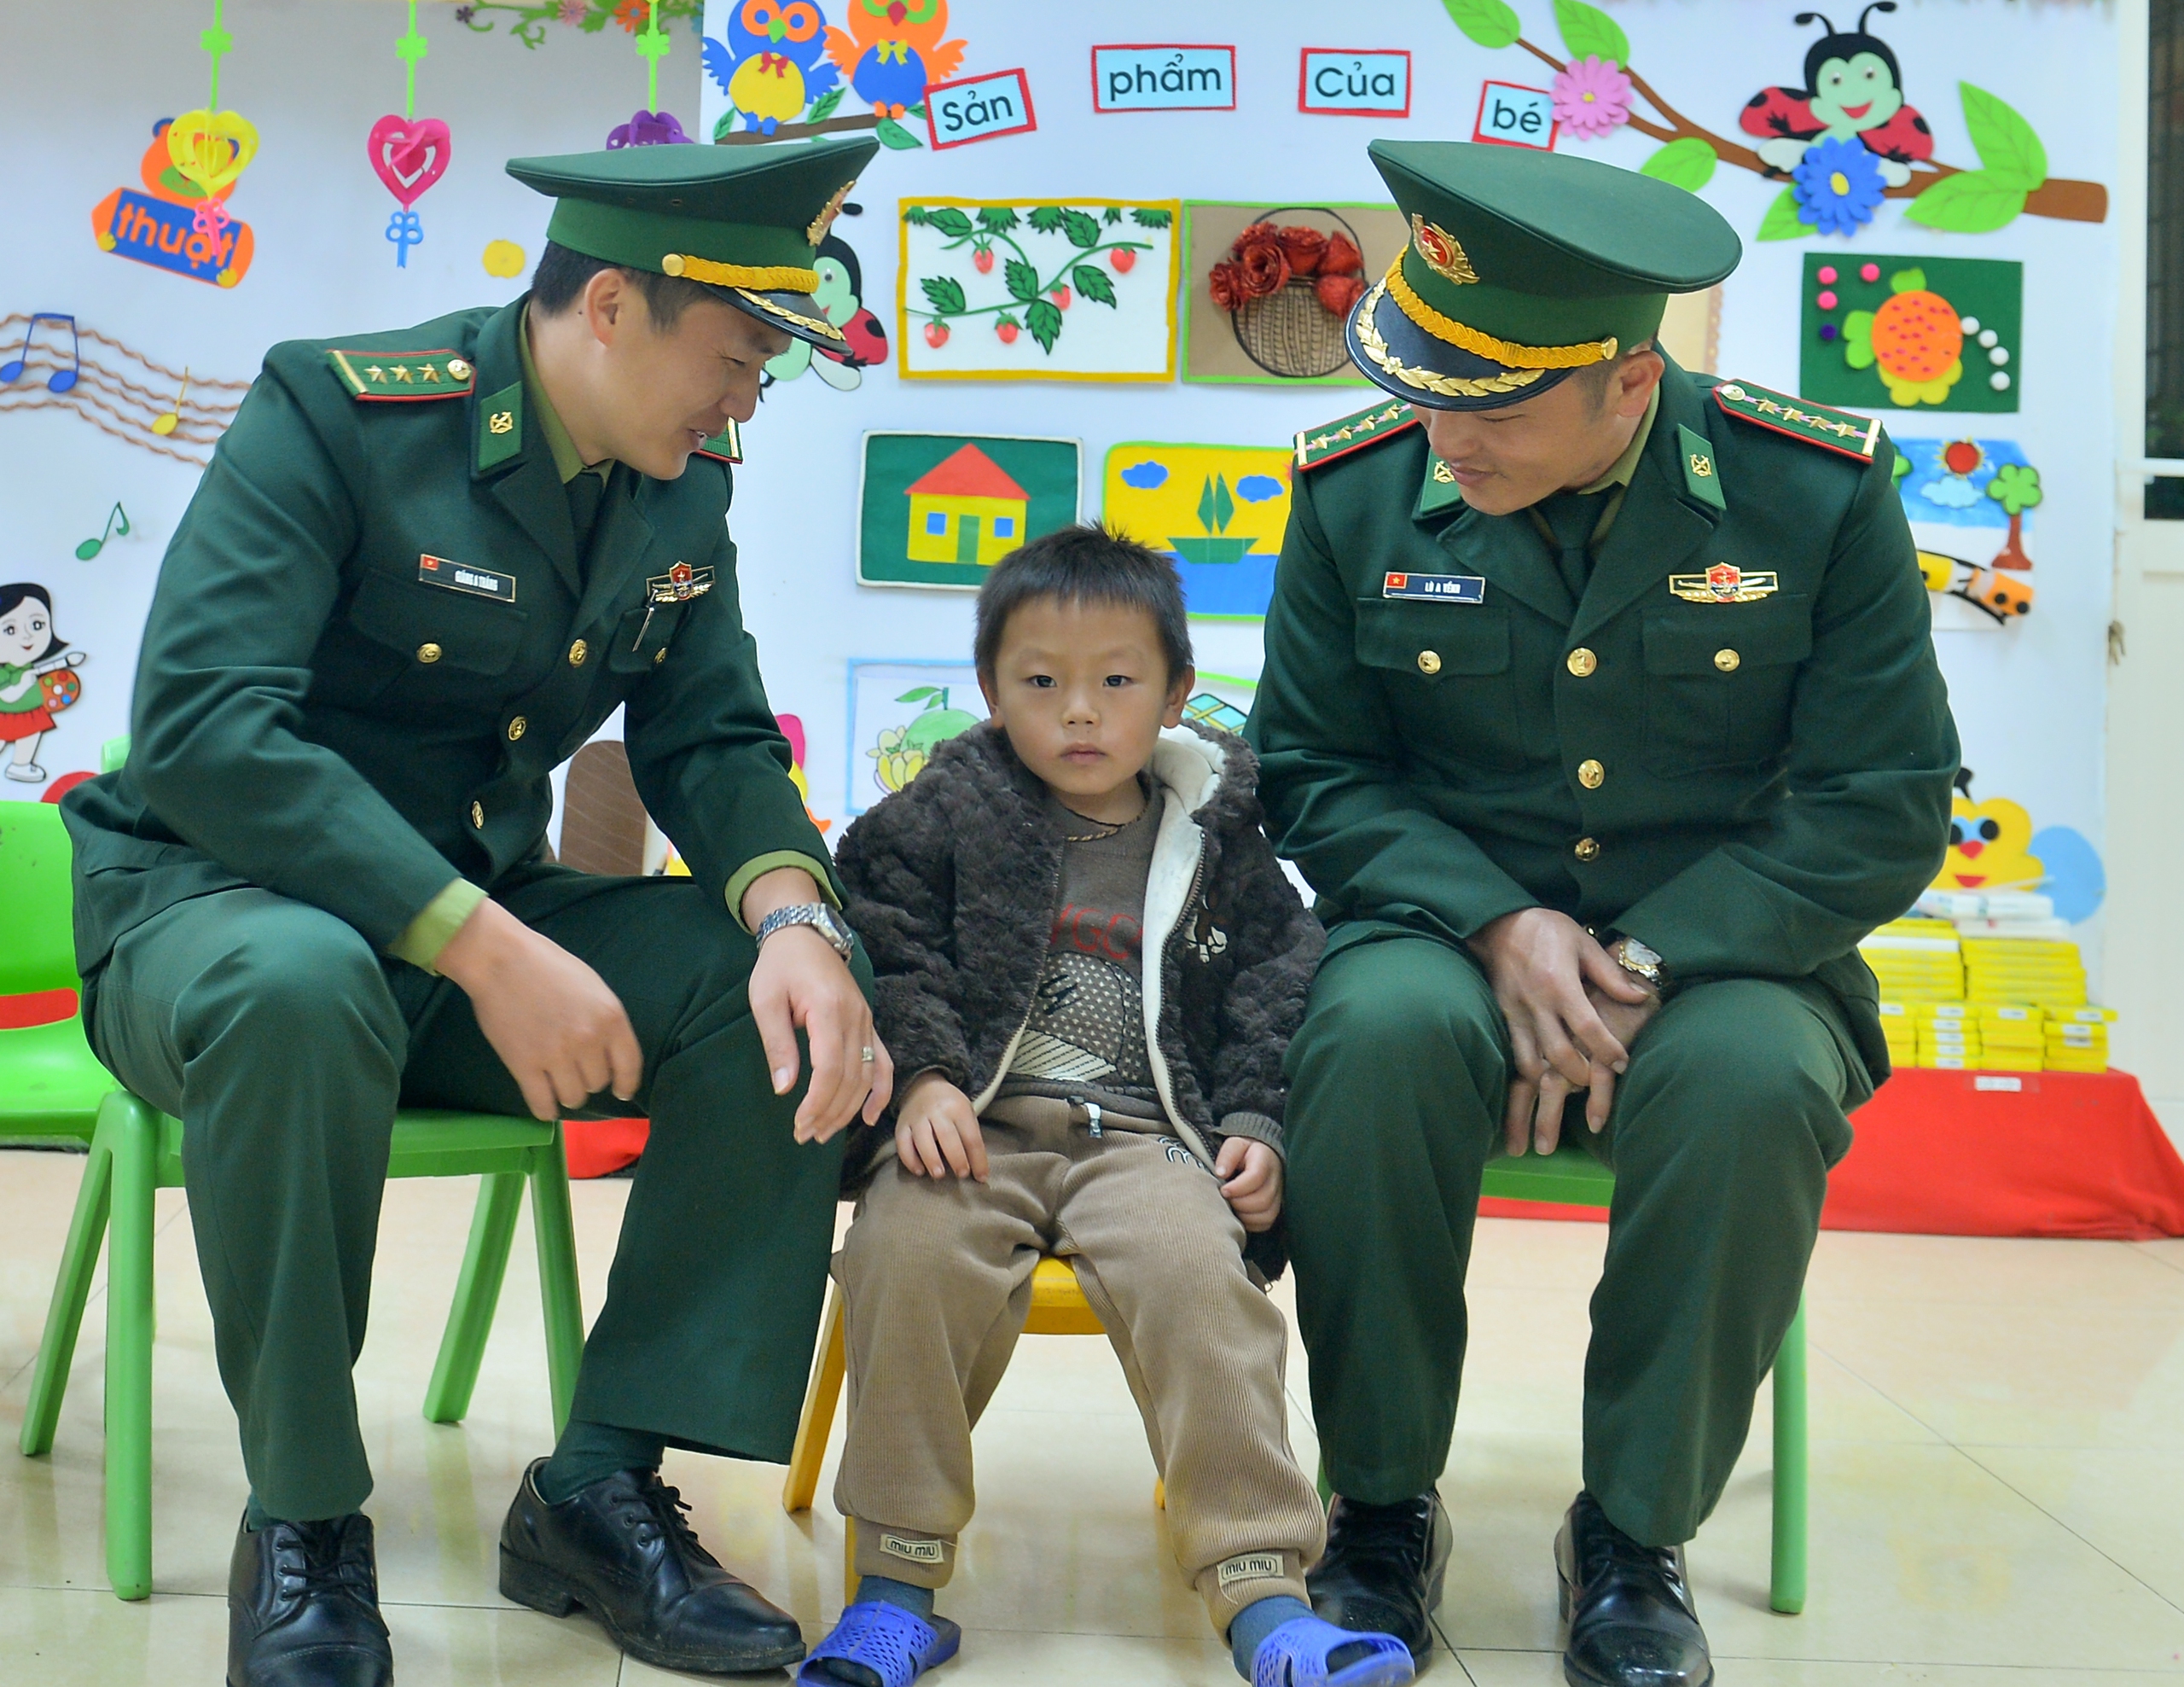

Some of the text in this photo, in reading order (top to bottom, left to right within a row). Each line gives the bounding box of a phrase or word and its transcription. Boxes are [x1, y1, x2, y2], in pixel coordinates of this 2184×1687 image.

[942, 53, 1542, 133] Sản phẩm Của bé
